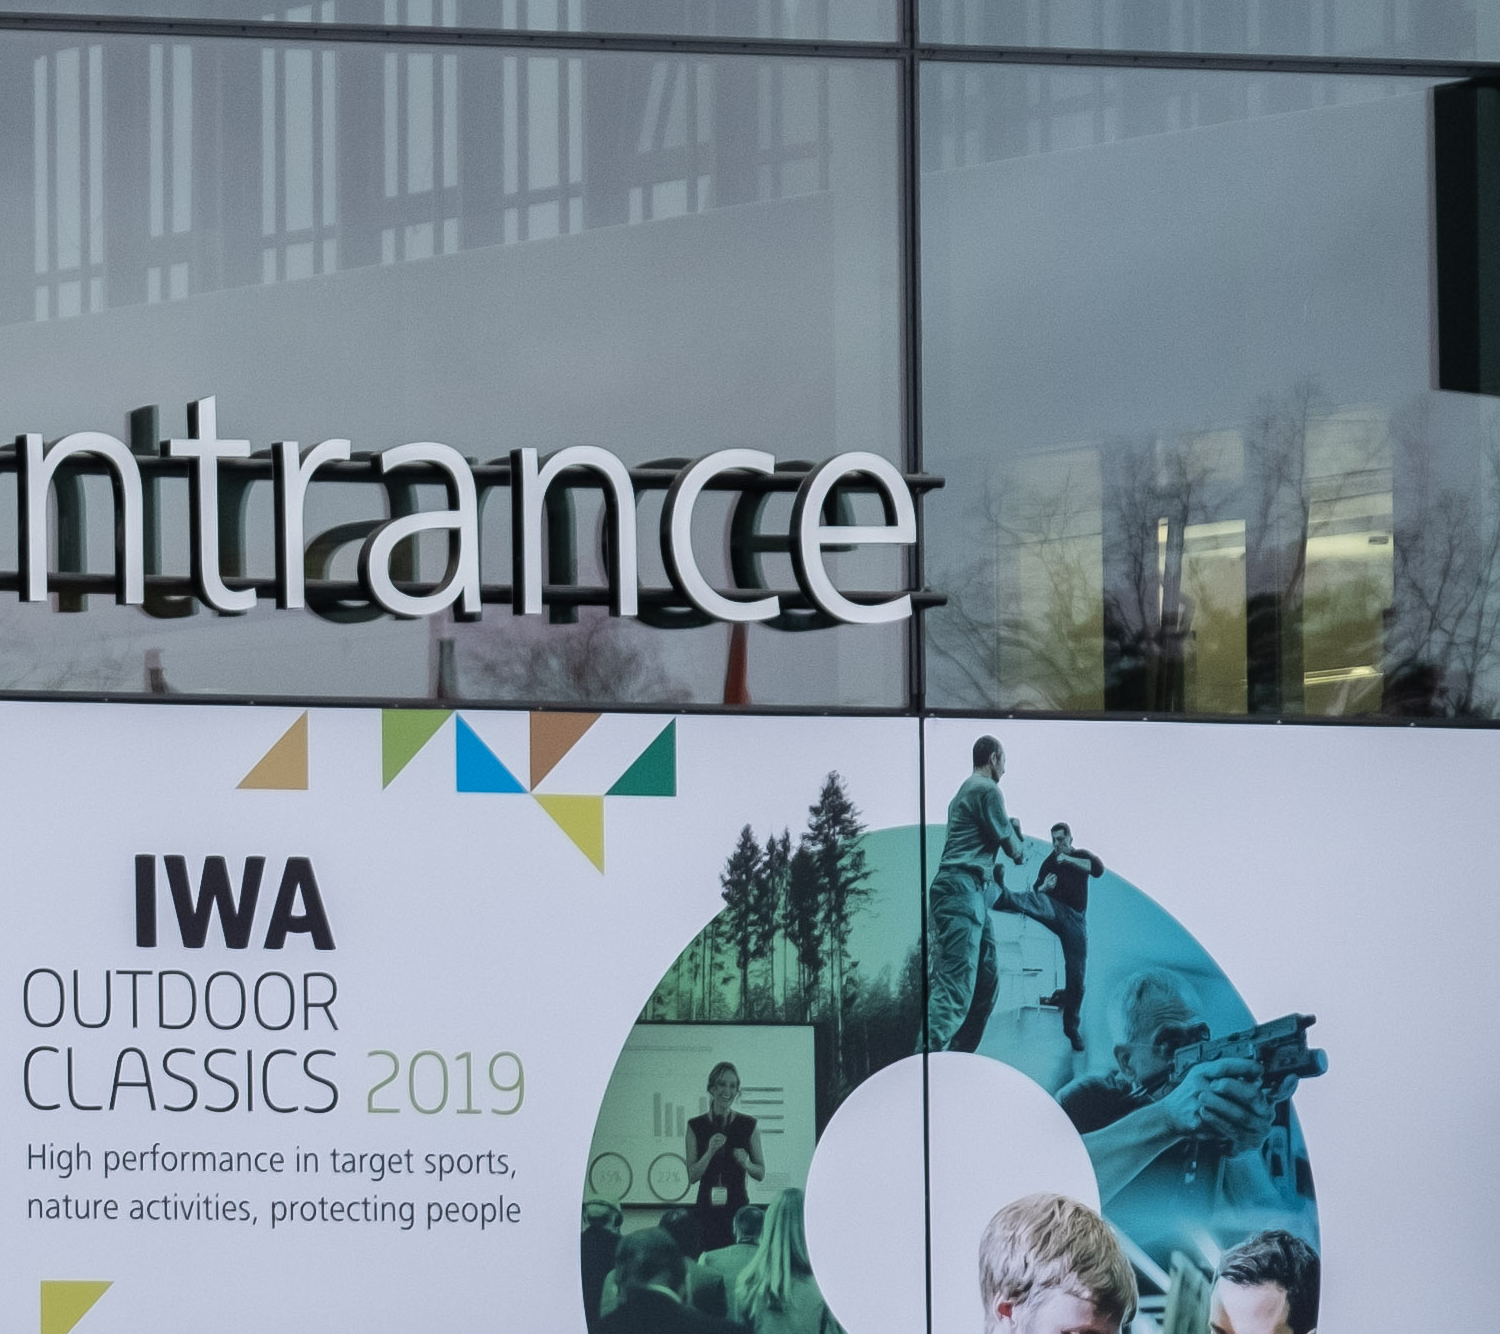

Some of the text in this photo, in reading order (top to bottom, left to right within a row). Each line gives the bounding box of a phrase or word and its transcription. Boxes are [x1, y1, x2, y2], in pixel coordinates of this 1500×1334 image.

[134, 854, 337, 951] IWA
[23, 968, 340, 1031] OUTDOOR
[23, 1045, 526, 1116] CLASSICS 2019
[28, 1142, 517, 1182] High performance in target sports,
[27, 1192, 522, 1231] nature activities, protecting people
